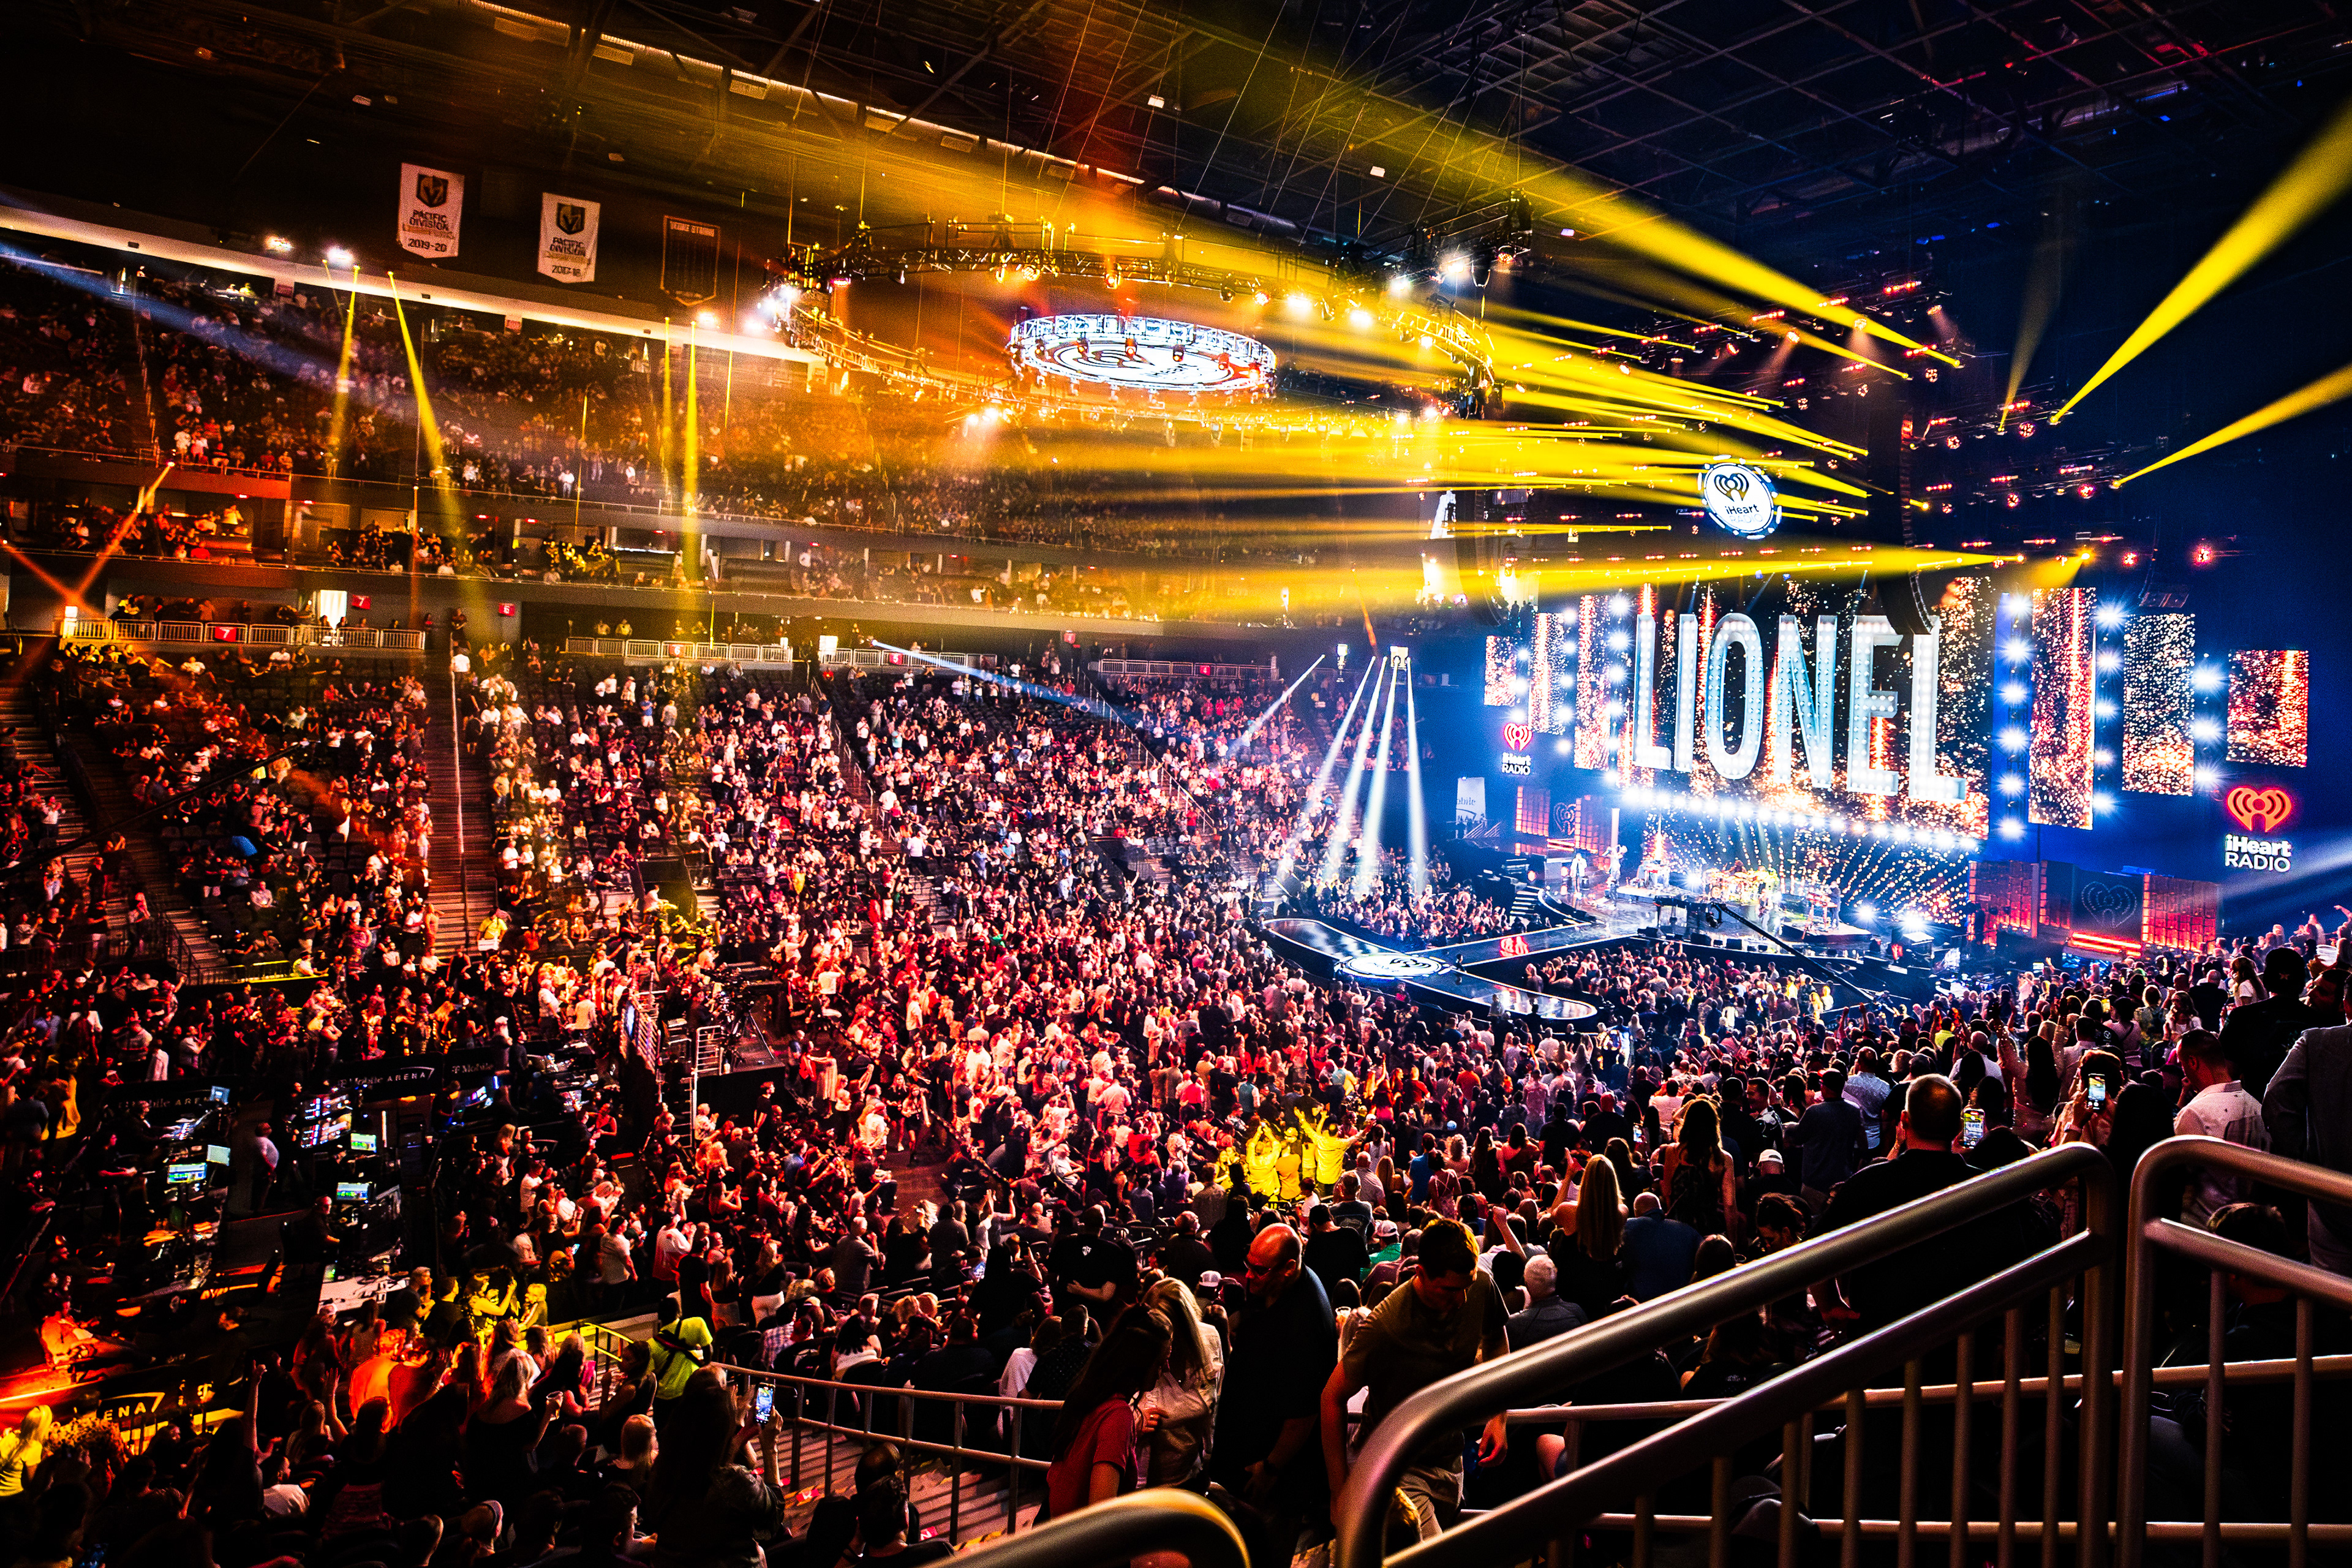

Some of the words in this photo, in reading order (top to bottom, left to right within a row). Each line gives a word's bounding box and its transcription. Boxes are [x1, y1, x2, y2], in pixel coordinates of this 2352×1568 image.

[412, 209, 447, 223] PACIFIC
[409, 217, 449, 231] DIVISION
[408, 238, 447, 252] 2019-20
[1725, 504, 1759, 514] iHeart
[1729, 513, 1763, 524] RADIO
[222, 629, 230, 639] 7
[674, 646, 680, 655] 6
[1632, 612, 1966, 800] LIONEL
[1501, 763, 1531, 775] RADIO
[2225, 834, 2292, 857] iHeart
[2225, 852, 2291, 872] RADIO
[387, 1072, 426, 1082] ARENA
